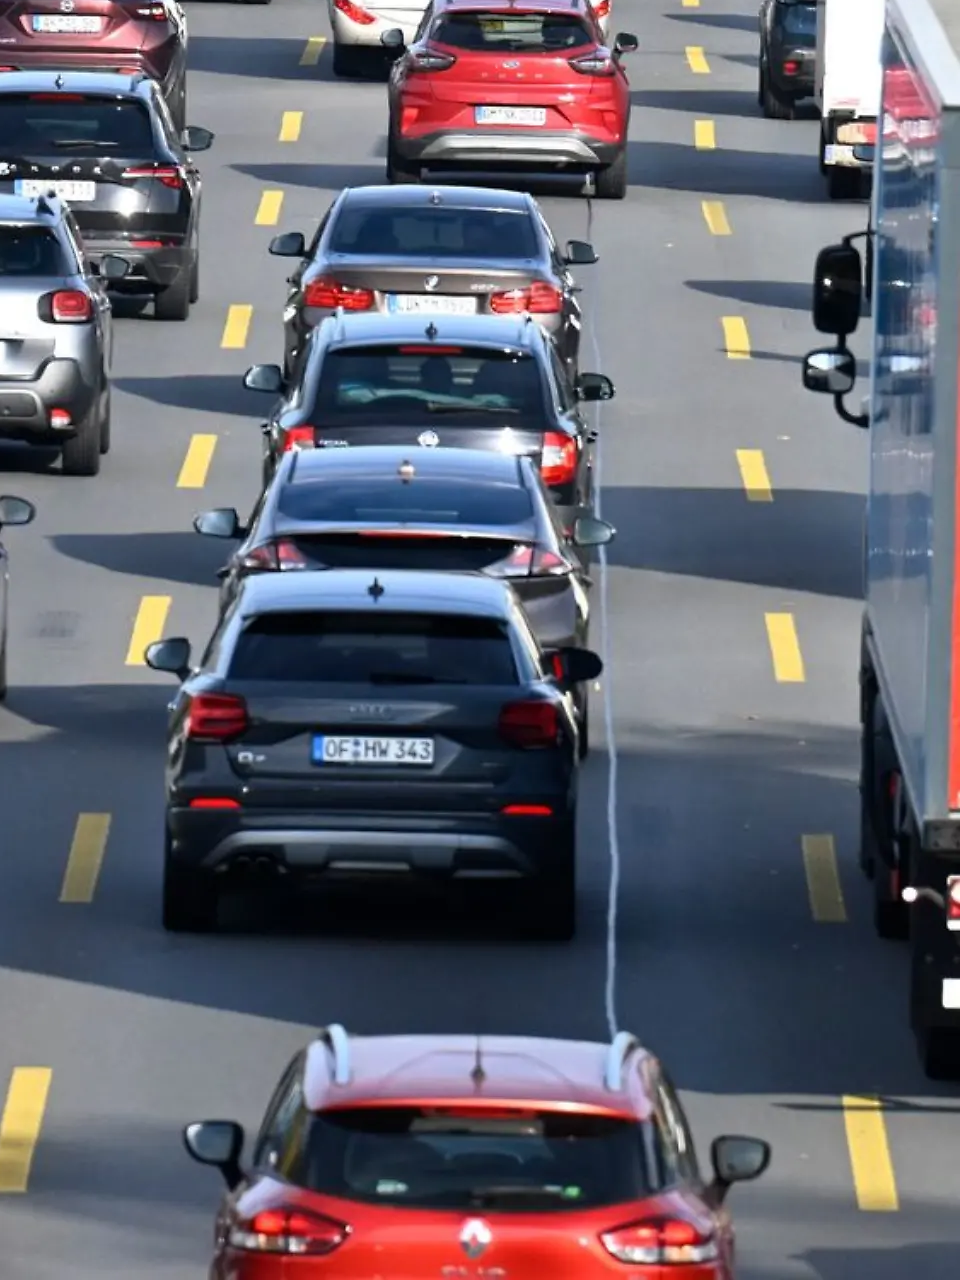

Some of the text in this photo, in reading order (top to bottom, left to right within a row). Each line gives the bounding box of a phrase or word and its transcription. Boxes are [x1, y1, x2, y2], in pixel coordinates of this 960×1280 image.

[324, 738, 432, 763] OF HW 343
